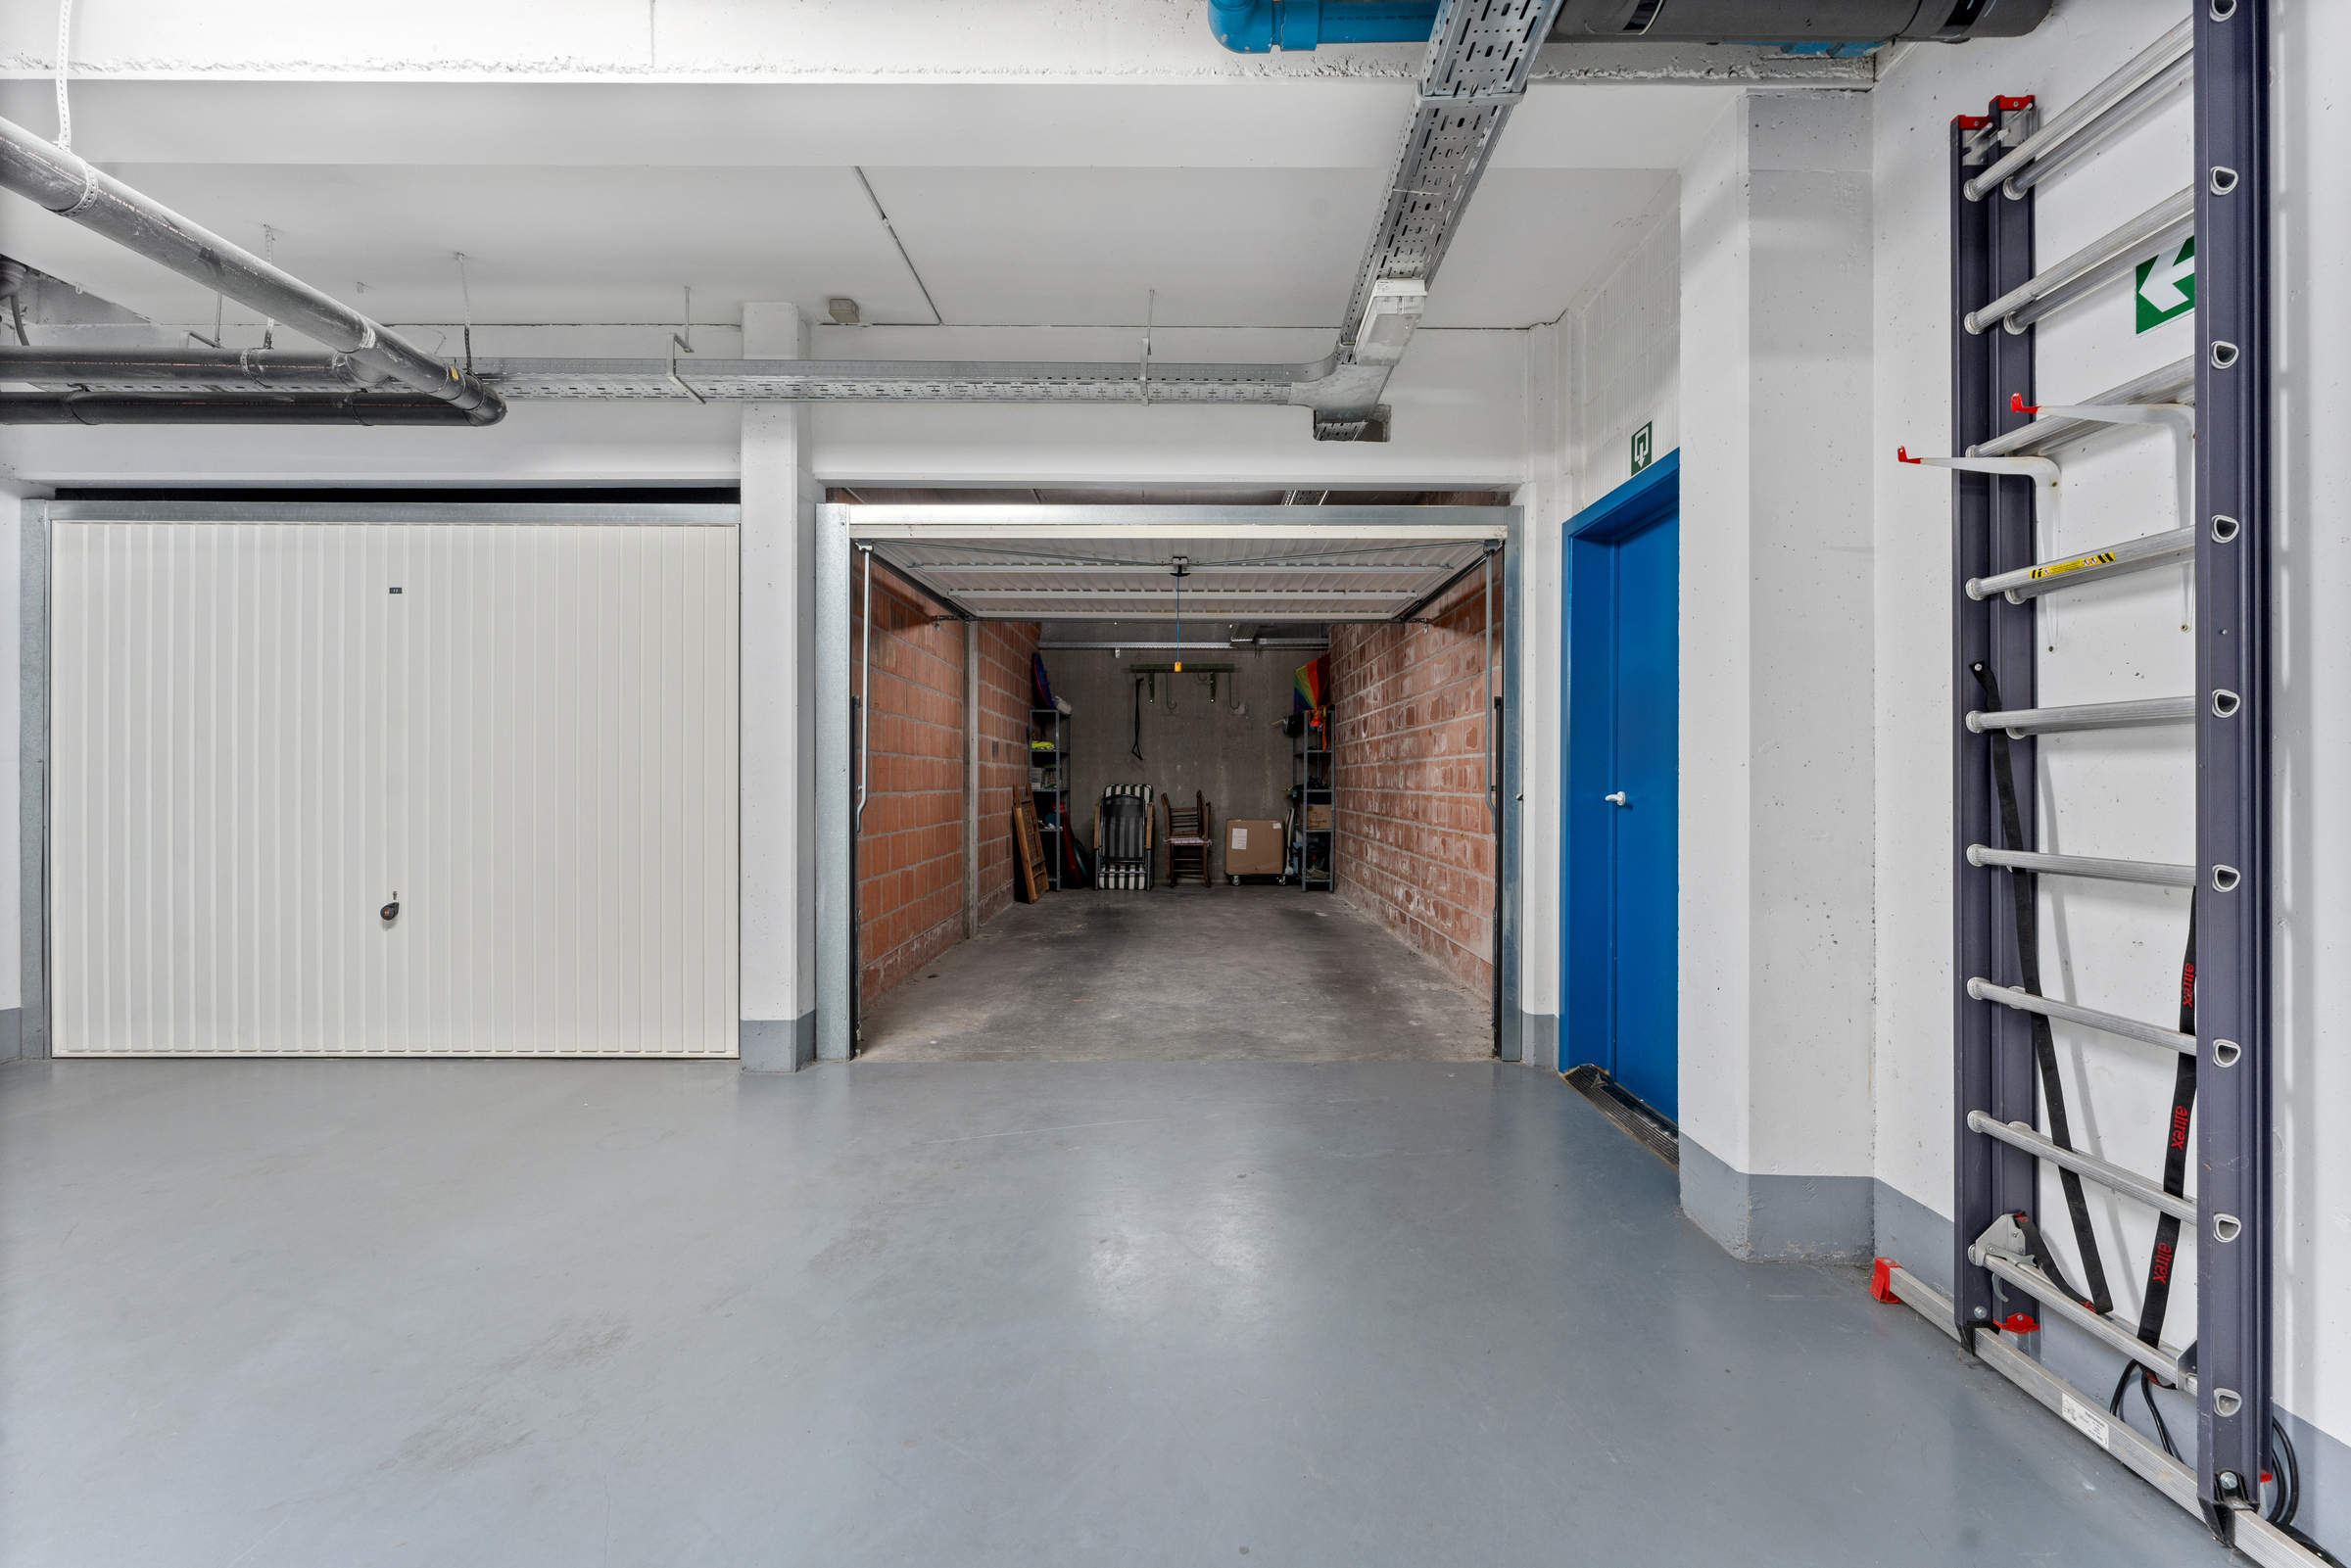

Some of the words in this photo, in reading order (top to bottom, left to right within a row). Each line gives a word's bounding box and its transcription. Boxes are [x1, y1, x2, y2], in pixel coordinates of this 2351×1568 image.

[2183, 963, 2195, 1009] altrex
[2171, 1106, 2189, 1151] altrex
[2152, 1242, 2173, 1285] altrex
